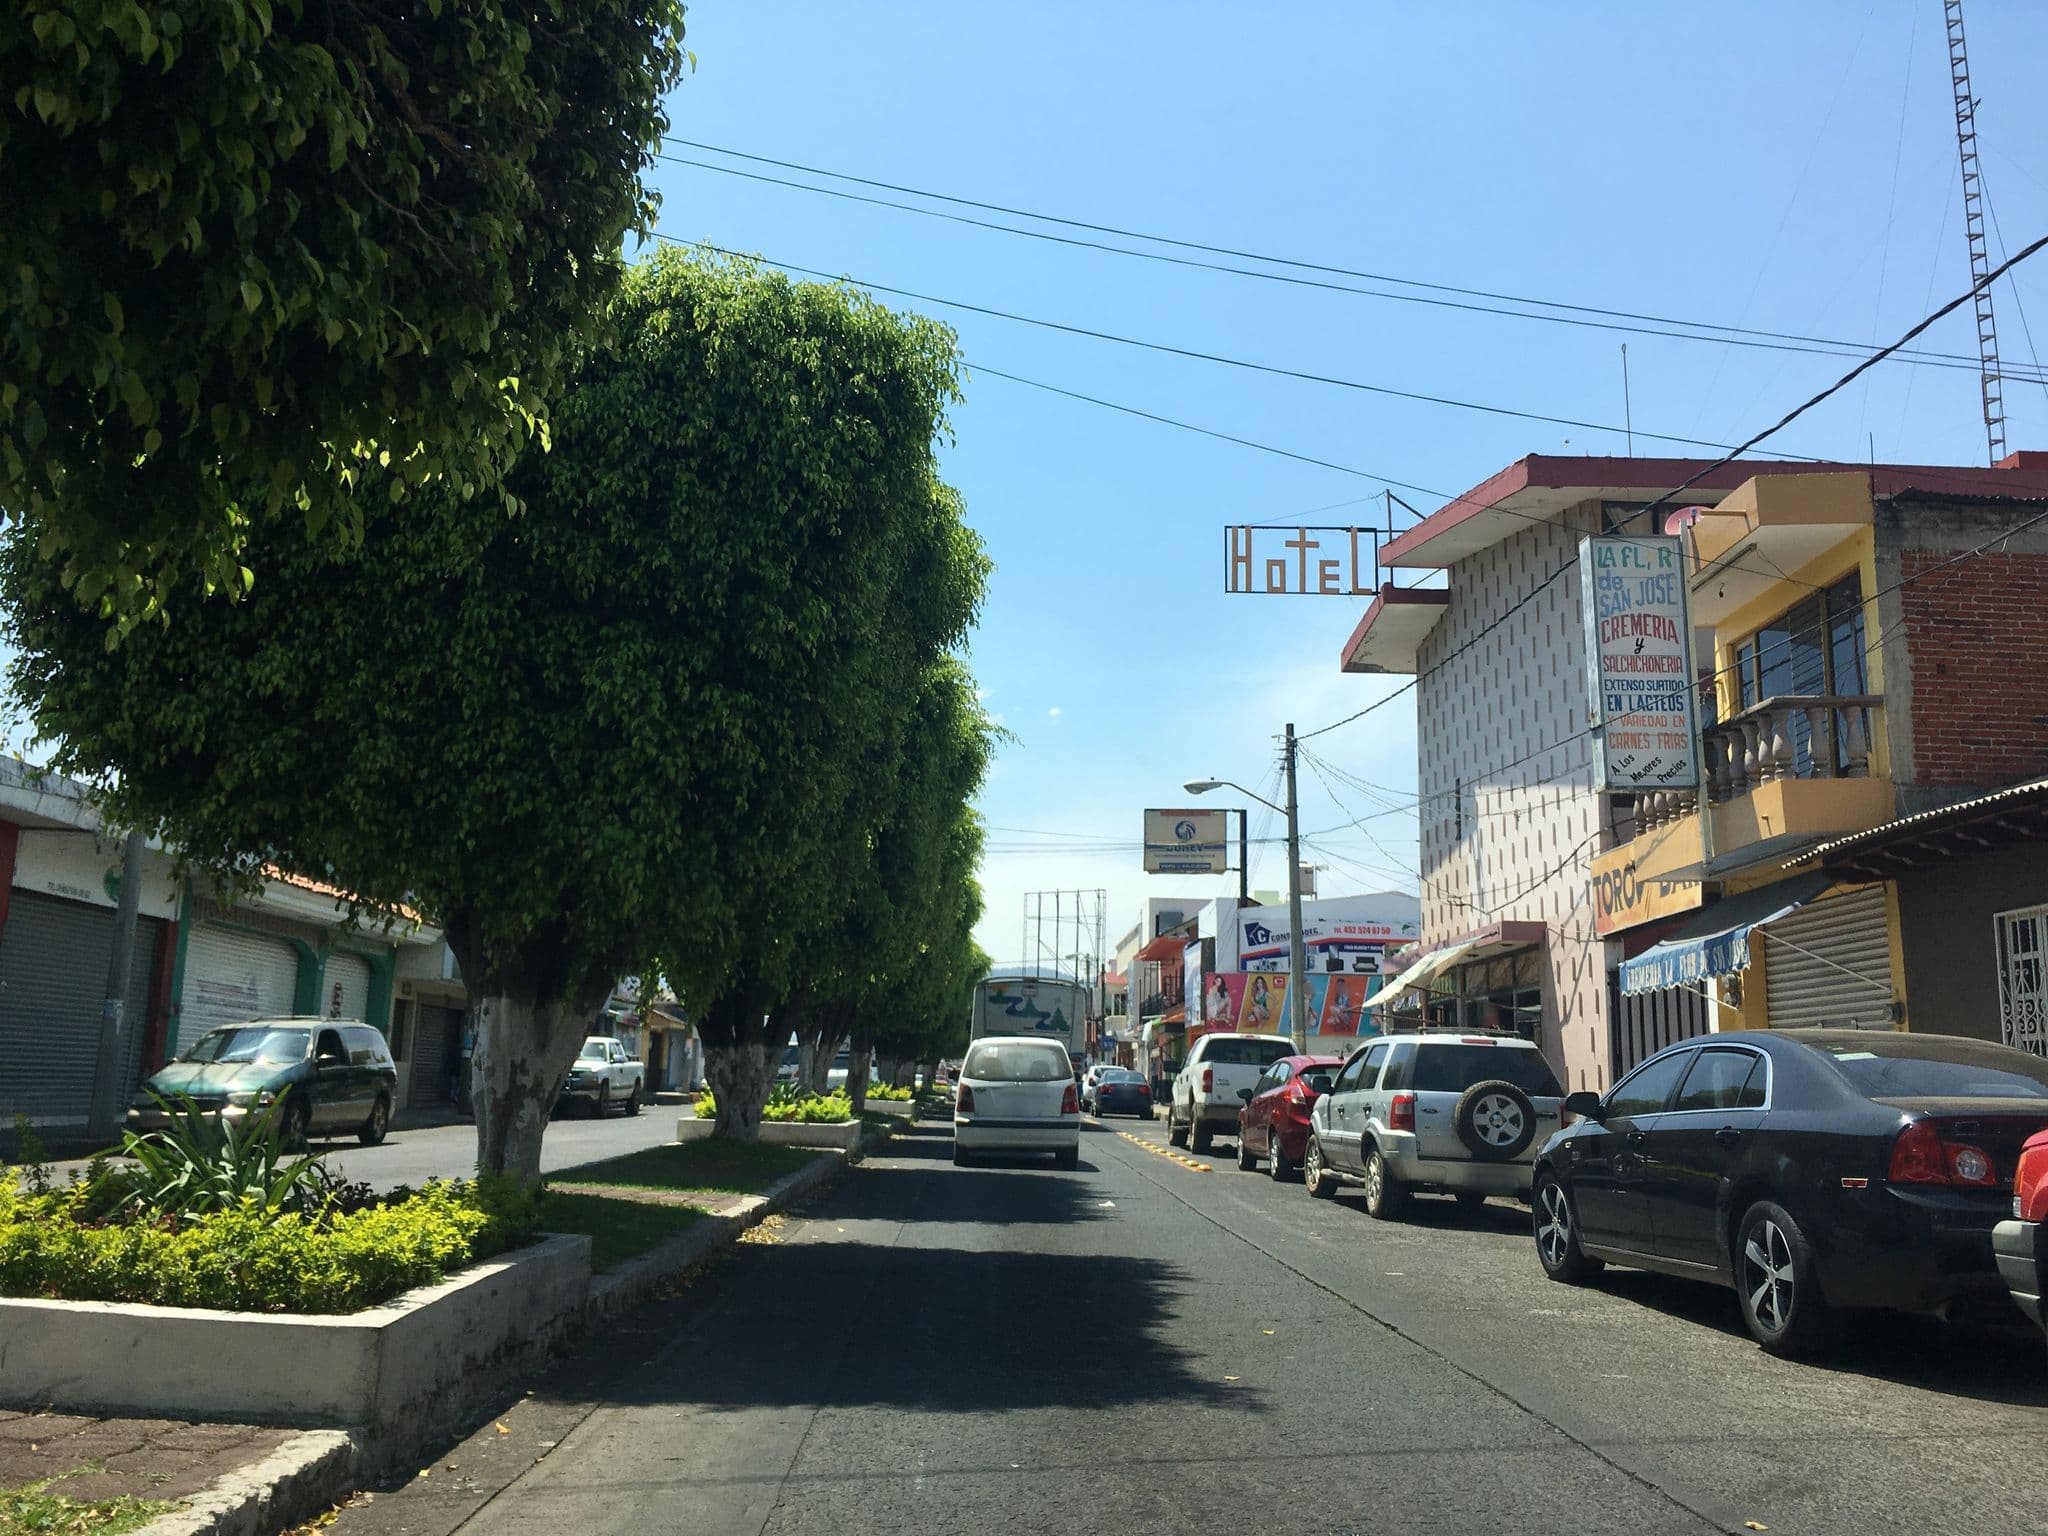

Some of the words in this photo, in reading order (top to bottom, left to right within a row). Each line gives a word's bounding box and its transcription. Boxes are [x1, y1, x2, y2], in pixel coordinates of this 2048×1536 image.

[1597, 546, 1617, 568] LA
[1599, 588, 1632, 617] SAN
[1635, 572, 1678, 606] JOSE
[1601, 612, 1680, 645] CREMERIA
[1602, 655, 1684, 673] SALCHICHONERIA
[1604, 680, 1645, 691] EXTENSO
[1646, 680, 1685, 692] SURTIDO
[1606, 694, 1623, 711] EN
[1629, 694, 1685, 711] LACTEOS
[1620, 714, 1668, 727] VARIEDAD
[1673, 715, 1686, 728] EN
[1608, 732, 1651, 749] CARNES
[1658, 732, 1688, 750] FRIAS
[1611, 765, 1620, 776] A
